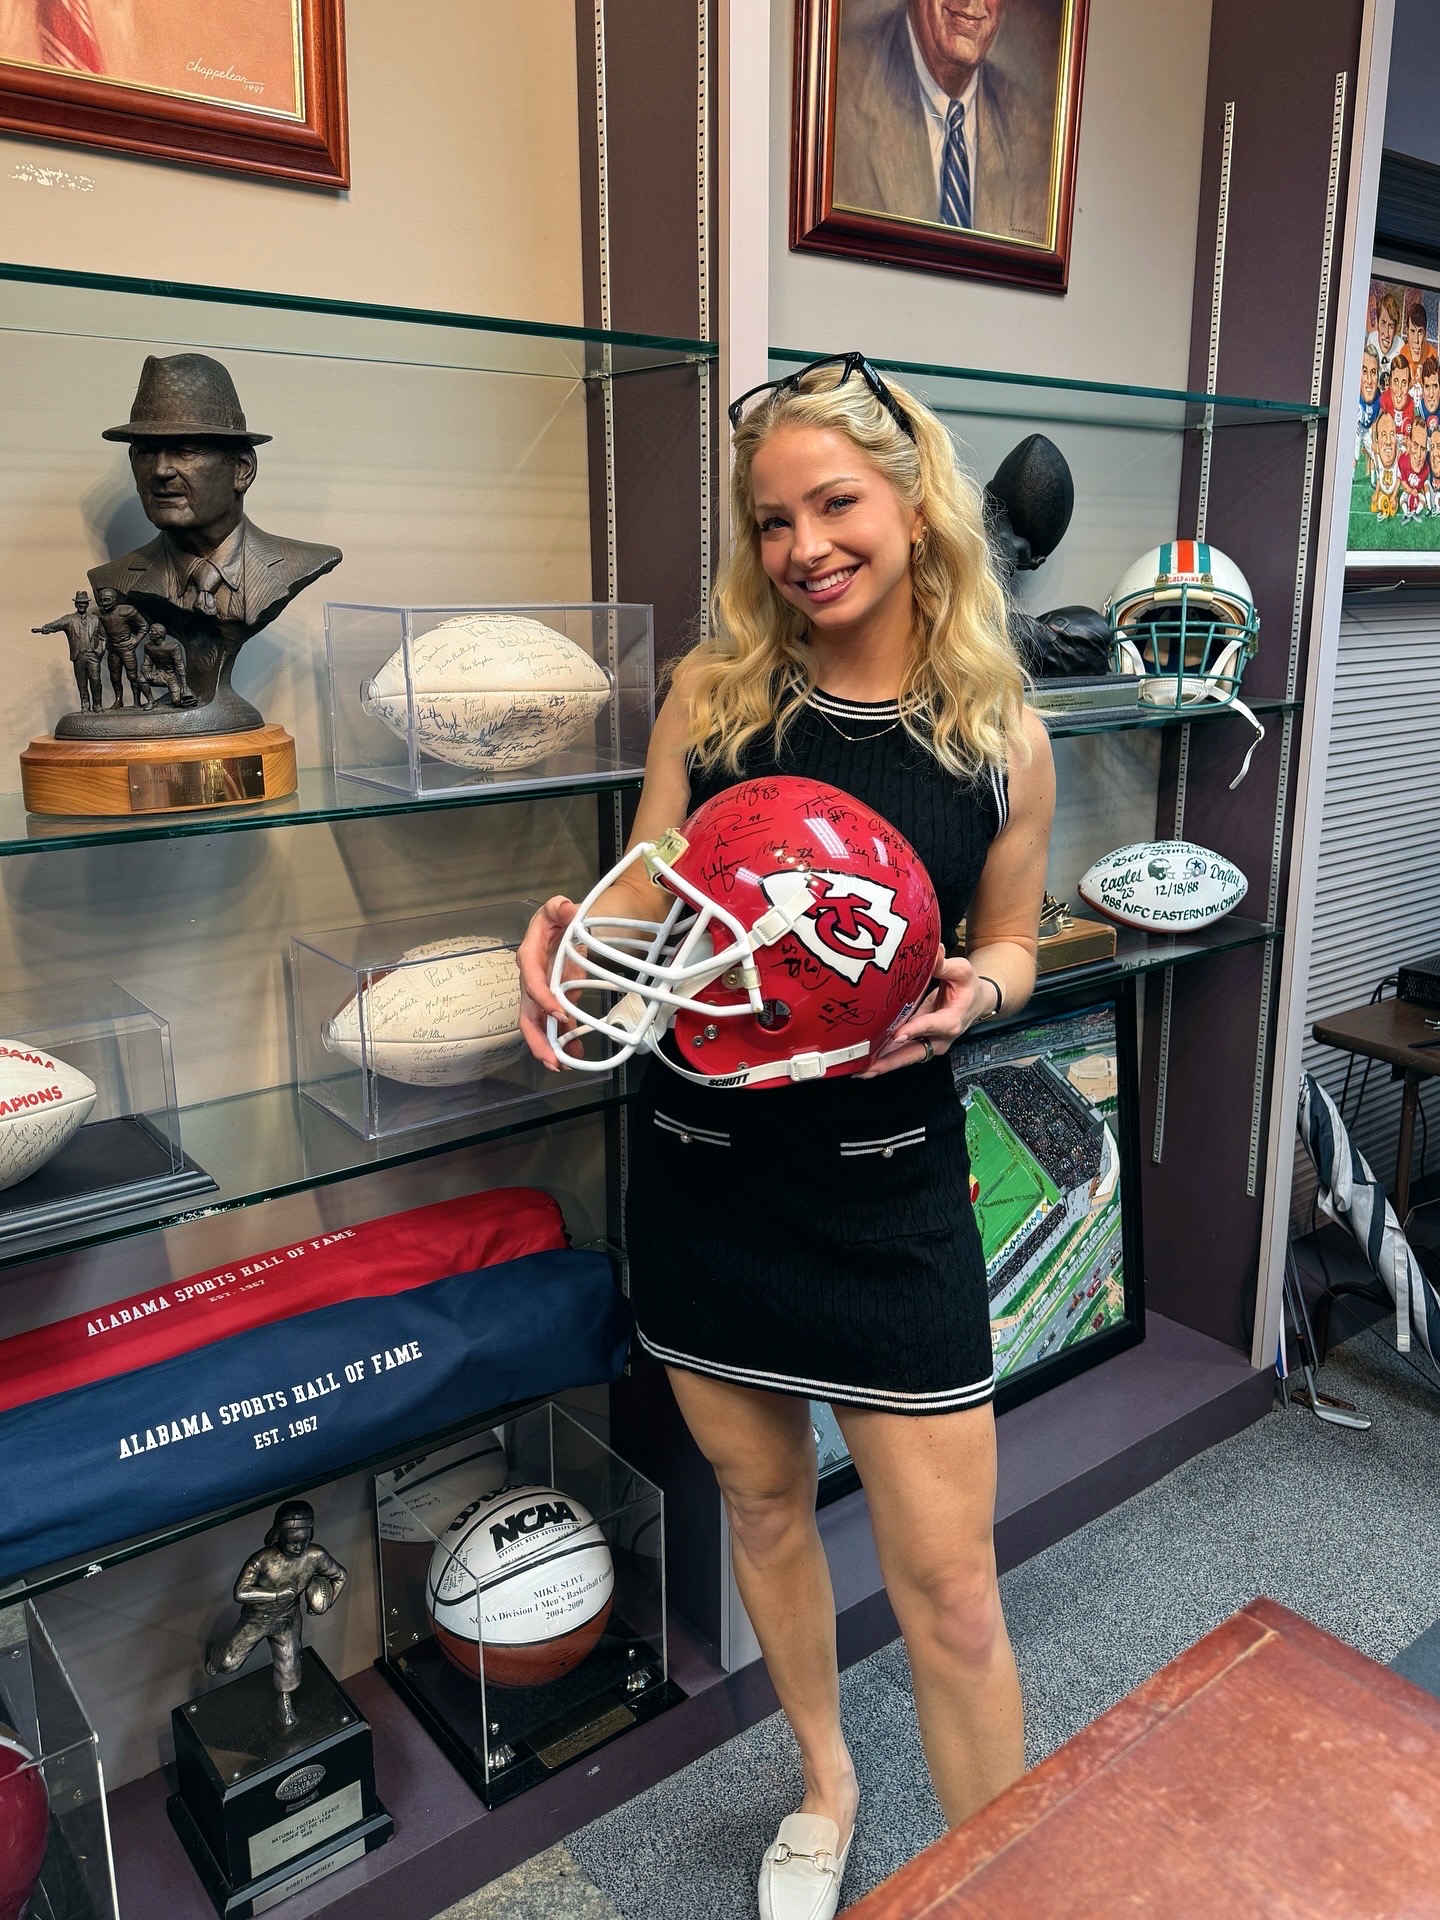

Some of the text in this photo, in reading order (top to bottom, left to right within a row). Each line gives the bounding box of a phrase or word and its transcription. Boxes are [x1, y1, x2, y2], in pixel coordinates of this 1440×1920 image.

[1101, 863, 1240, 892] Eagles Dallas
[1121, 881, 1226, 900] 23 12/18/88 7
[1101, 894, 1122, 910] 1988
[1123, 903, 1150, 918] NFC
[1152, 907, 1204, 921] EASTERN
[1220, 884, 1246, 911] CHAMPS
[708, 1072, 750, 1087] SCHUTT
[87, 1229, 356, 1337] ALABAMA SPORTS HALL OF FAME
[208, 1279, 266, 1303] EST. 1967
[119, 1340, 423, 1460] ALABAMA SPORTS HALL OF FAME
[254, 1415, 318, 1450] EST. 1967
[489, 1501, 579, 1552] NCAA
[498, 1542, 523, 1559] OFFICIAL
[525, 1534, 540, 1543] NCAA
[541, 1525, 571, 1536] AUTOGRAPH
[469, 1612, 497, 1626] NCAA
[498, 1606, 533, 1621] Division
[541, 1594, 566, 1610] Men's
[567, 1578, 599, 1600] Basketball
[533, 1573, 585, 1600] MIKE SLIVE
[280, 1771, 323, 1794] TOUCHDOWN
[271, 1804, 340, 1844] NATIONAL FOOTBALL LEAGUE
[308, 1821, 318, 1830] THE
[319, 1814, 332, 1824] YEAR
[285, 1877, 304, 1892] BOBBY
